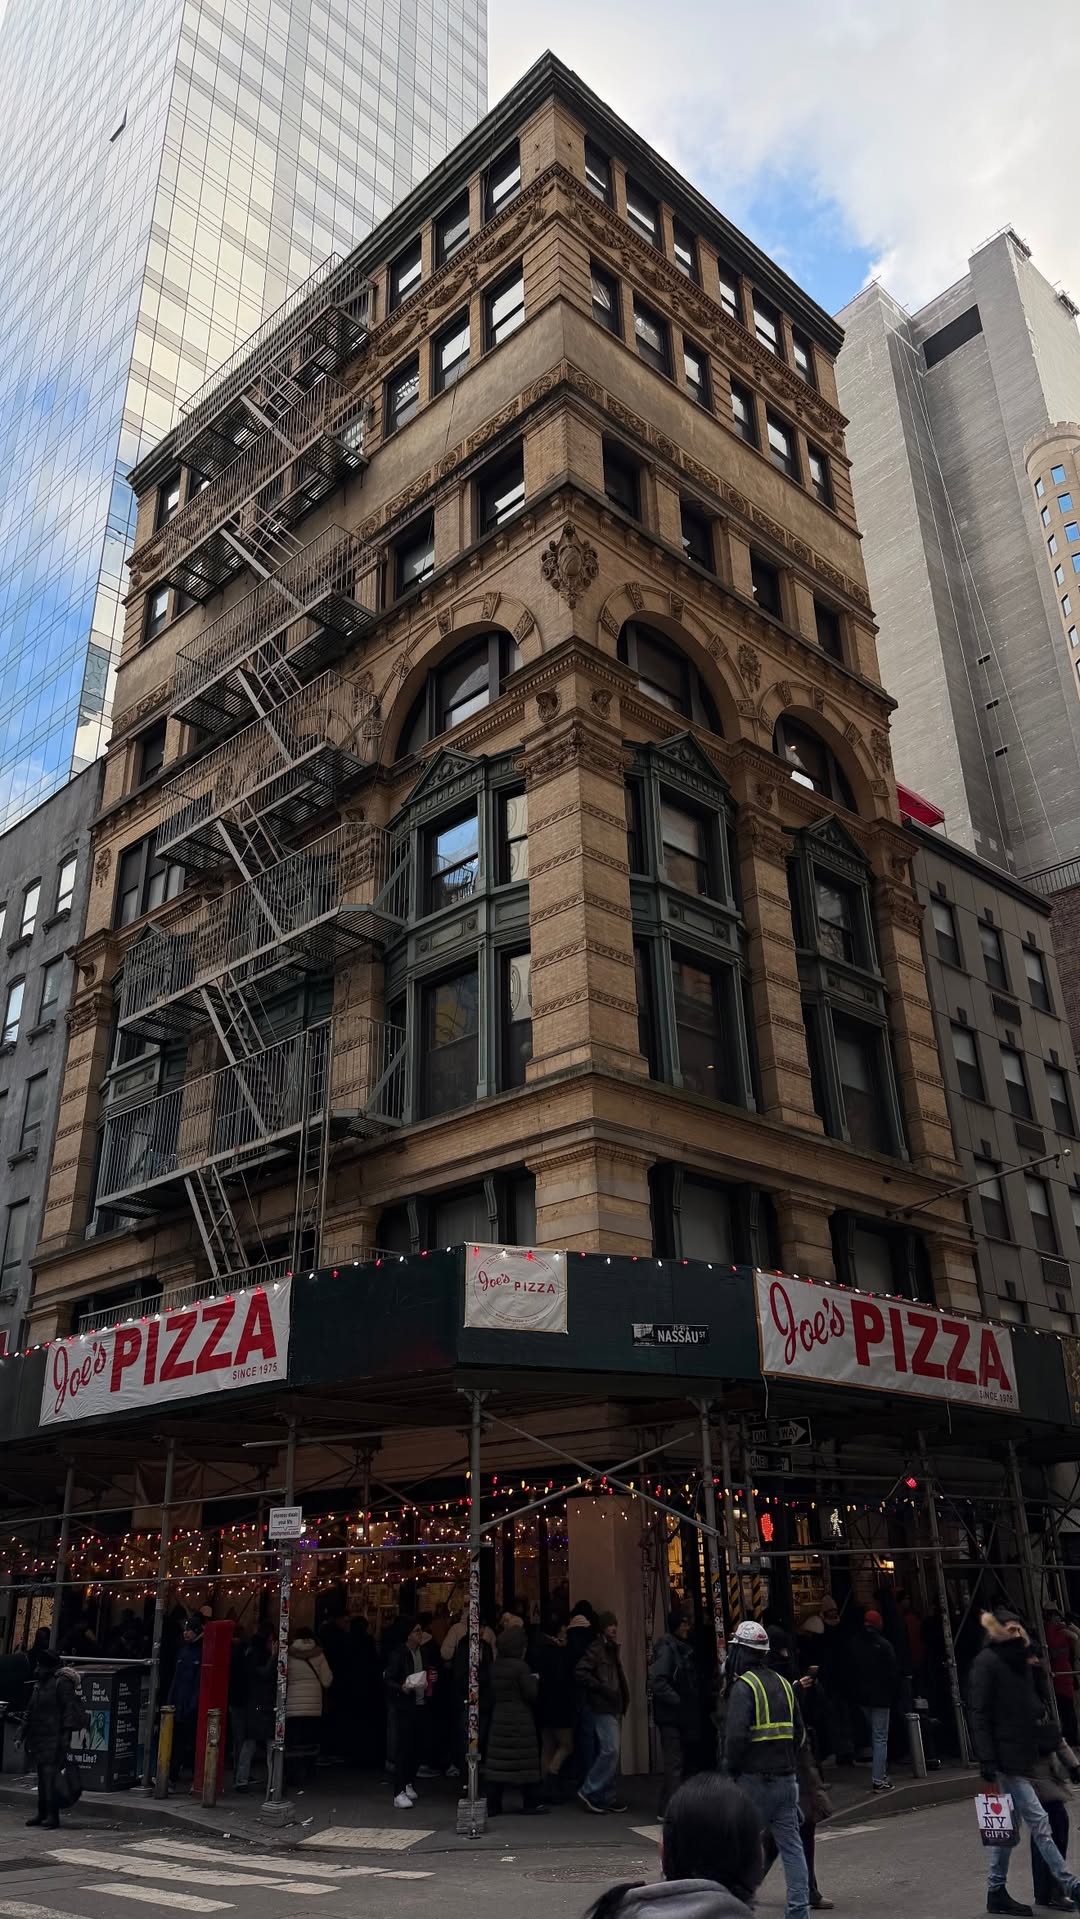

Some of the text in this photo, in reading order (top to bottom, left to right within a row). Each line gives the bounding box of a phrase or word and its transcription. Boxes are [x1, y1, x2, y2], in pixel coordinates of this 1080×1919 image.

[478, 1270, 555, 1294] Joe's PIZZA
[657, 1329, 706, 1343] NASSAU ST
[769, 1281, 1011, 1391] Joe's PIZZA
[53, 1292, 277, 1414] Joe's PIZZA
[232, 1362, 278, 1380] SINCE 1975
[979, 1390, 998, 1401] SINCE
[781, 1426, 799, 1439] WAY
[983, 1802, 991, 1815] I
[982, 1816, 1006, 1829] NY
[985, 1831, 1010, 1839] GIFTS
